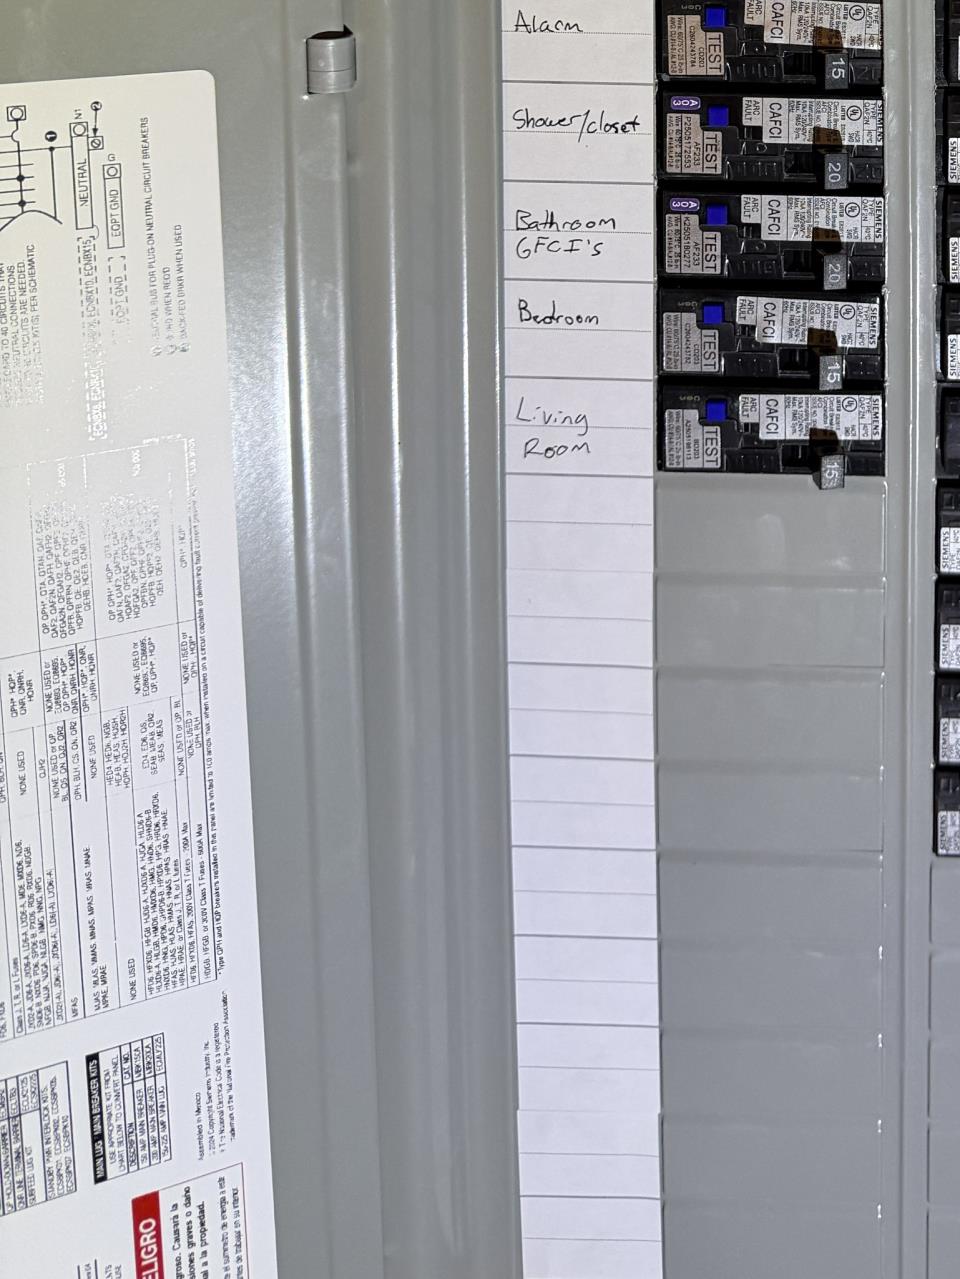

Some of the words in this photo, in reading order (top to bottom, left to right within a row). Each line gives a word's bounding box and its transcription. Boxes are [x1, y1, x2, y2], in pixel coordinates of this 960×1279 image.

[514, 10, 583, 33] Alarm
[771, 2, 784, 38] CAFCI
[709, 34, 721, 73] TEST
[832, 58, 844, 79] 15
[141, 117, 151, 159] BREAKERS
[769, 103, 782, 138] CAFCI
[706, 134, 717, 172] TEST
[78, 158, 88, 207] NEUTRAL
[828, 163, 840, 182] 20
[109, 190, 119, 210] GND
[144, 195, 155, 231] NEUTRAL
[768, 200, 780, 235] CAFCI
[111, 213, 120, 237] EQPT
[174, 225, 183, 247] USED
[516, 210, 615, 231] Bathroom
[517, 237, 603, 258] GFCI's
[705, 234, 717, 272] TEST
[27, 244, 37, 293] SCHEMATIC
[828, 264, 840, 283] 20
[518, 300, 600, 326] Bedroom
[738, 299, 746, 320] FAULT
[762, 303, 776, 338] CAFCI
[869, 307, 877, 345] SIEMENS
[704, 332, 716, 369] TEST
[827, 363, 840, 383] 15
[516, 397, 589, 436] Living
[741, 397, 749, 418] FAULT
[766, 399, 778, 434] CAFCI
[524, 440, 591, 458] Room
[706, 428, 717, 466] TEST
[185, 1220, 195, 1248] graves
